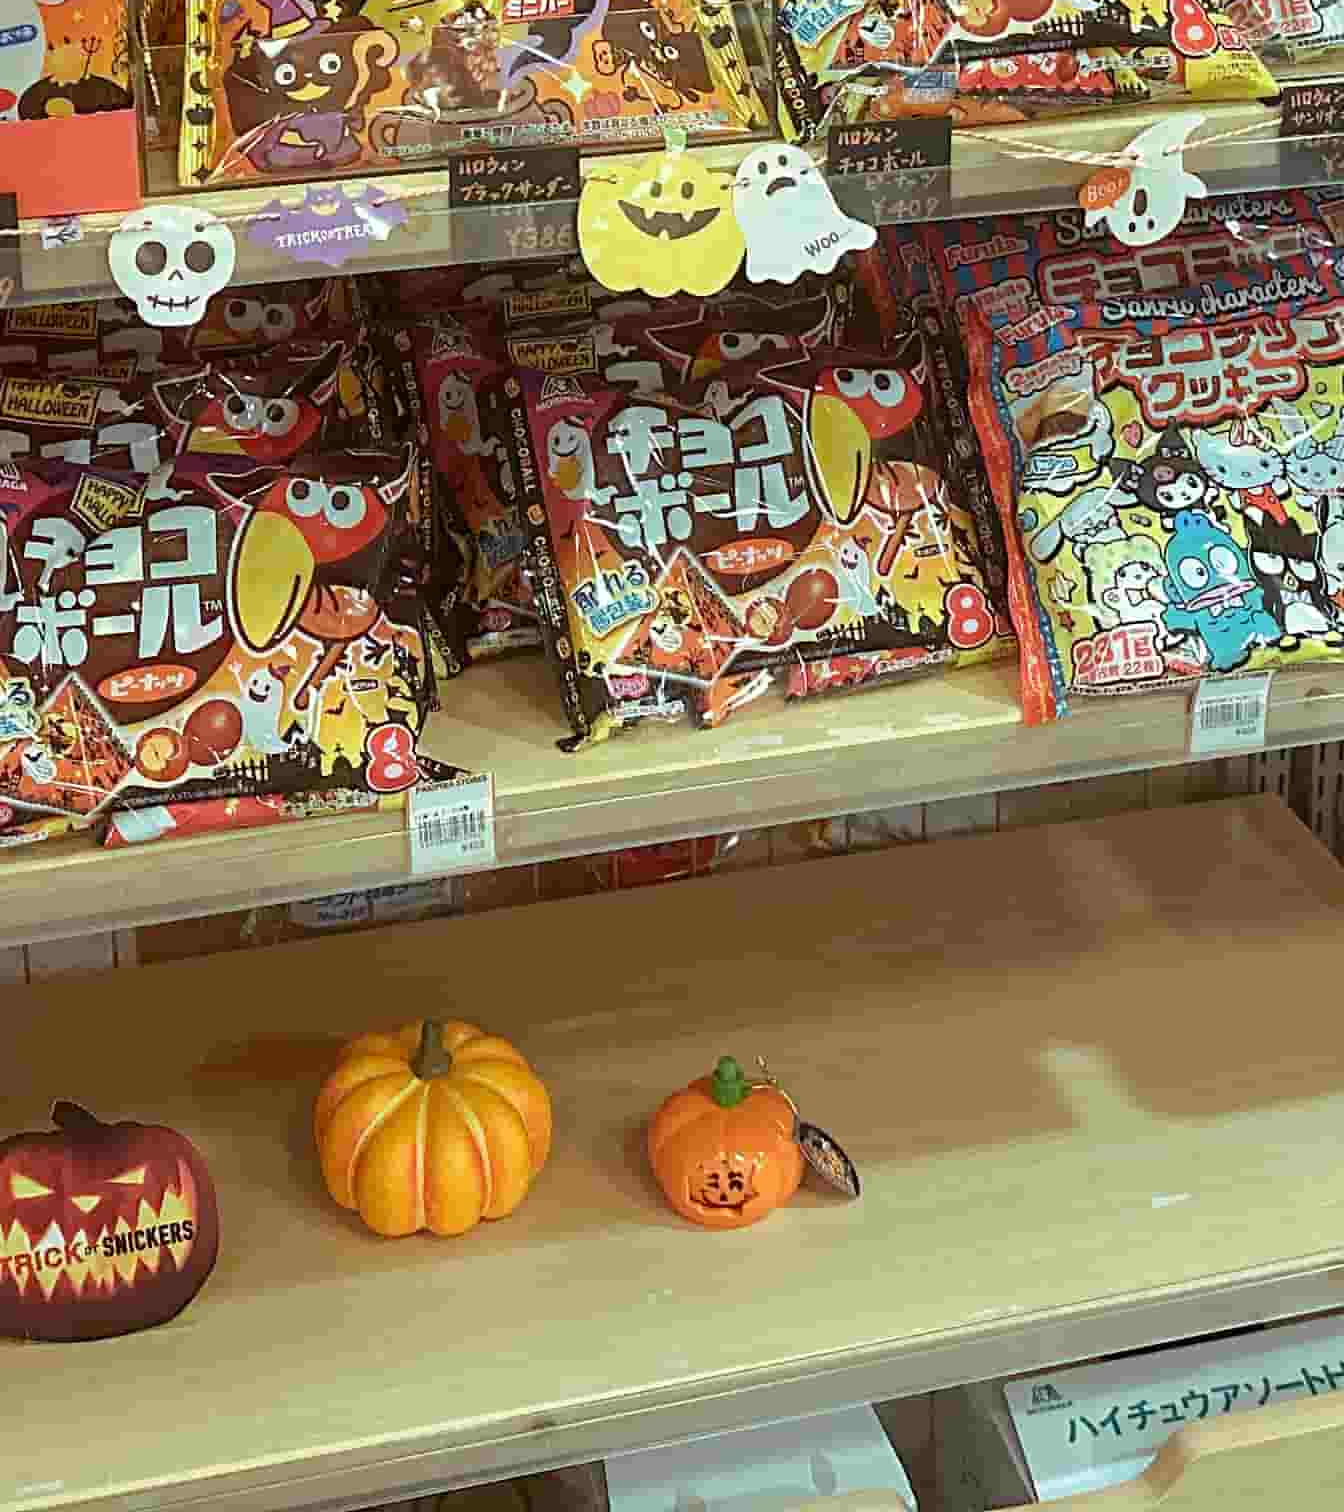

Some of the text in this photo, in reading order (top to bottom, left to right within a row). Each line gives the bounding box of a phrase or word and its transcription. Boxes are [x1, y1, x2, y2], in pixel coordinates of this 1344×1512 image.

[839, 150, 928, 177] チョコボール
[24, 504, 219, 592] チョコ
[14, 581, 224, 666] ボール
[946, 584, 994, 649] 8
[101, 1216, 196, 1259] SNICKERS
